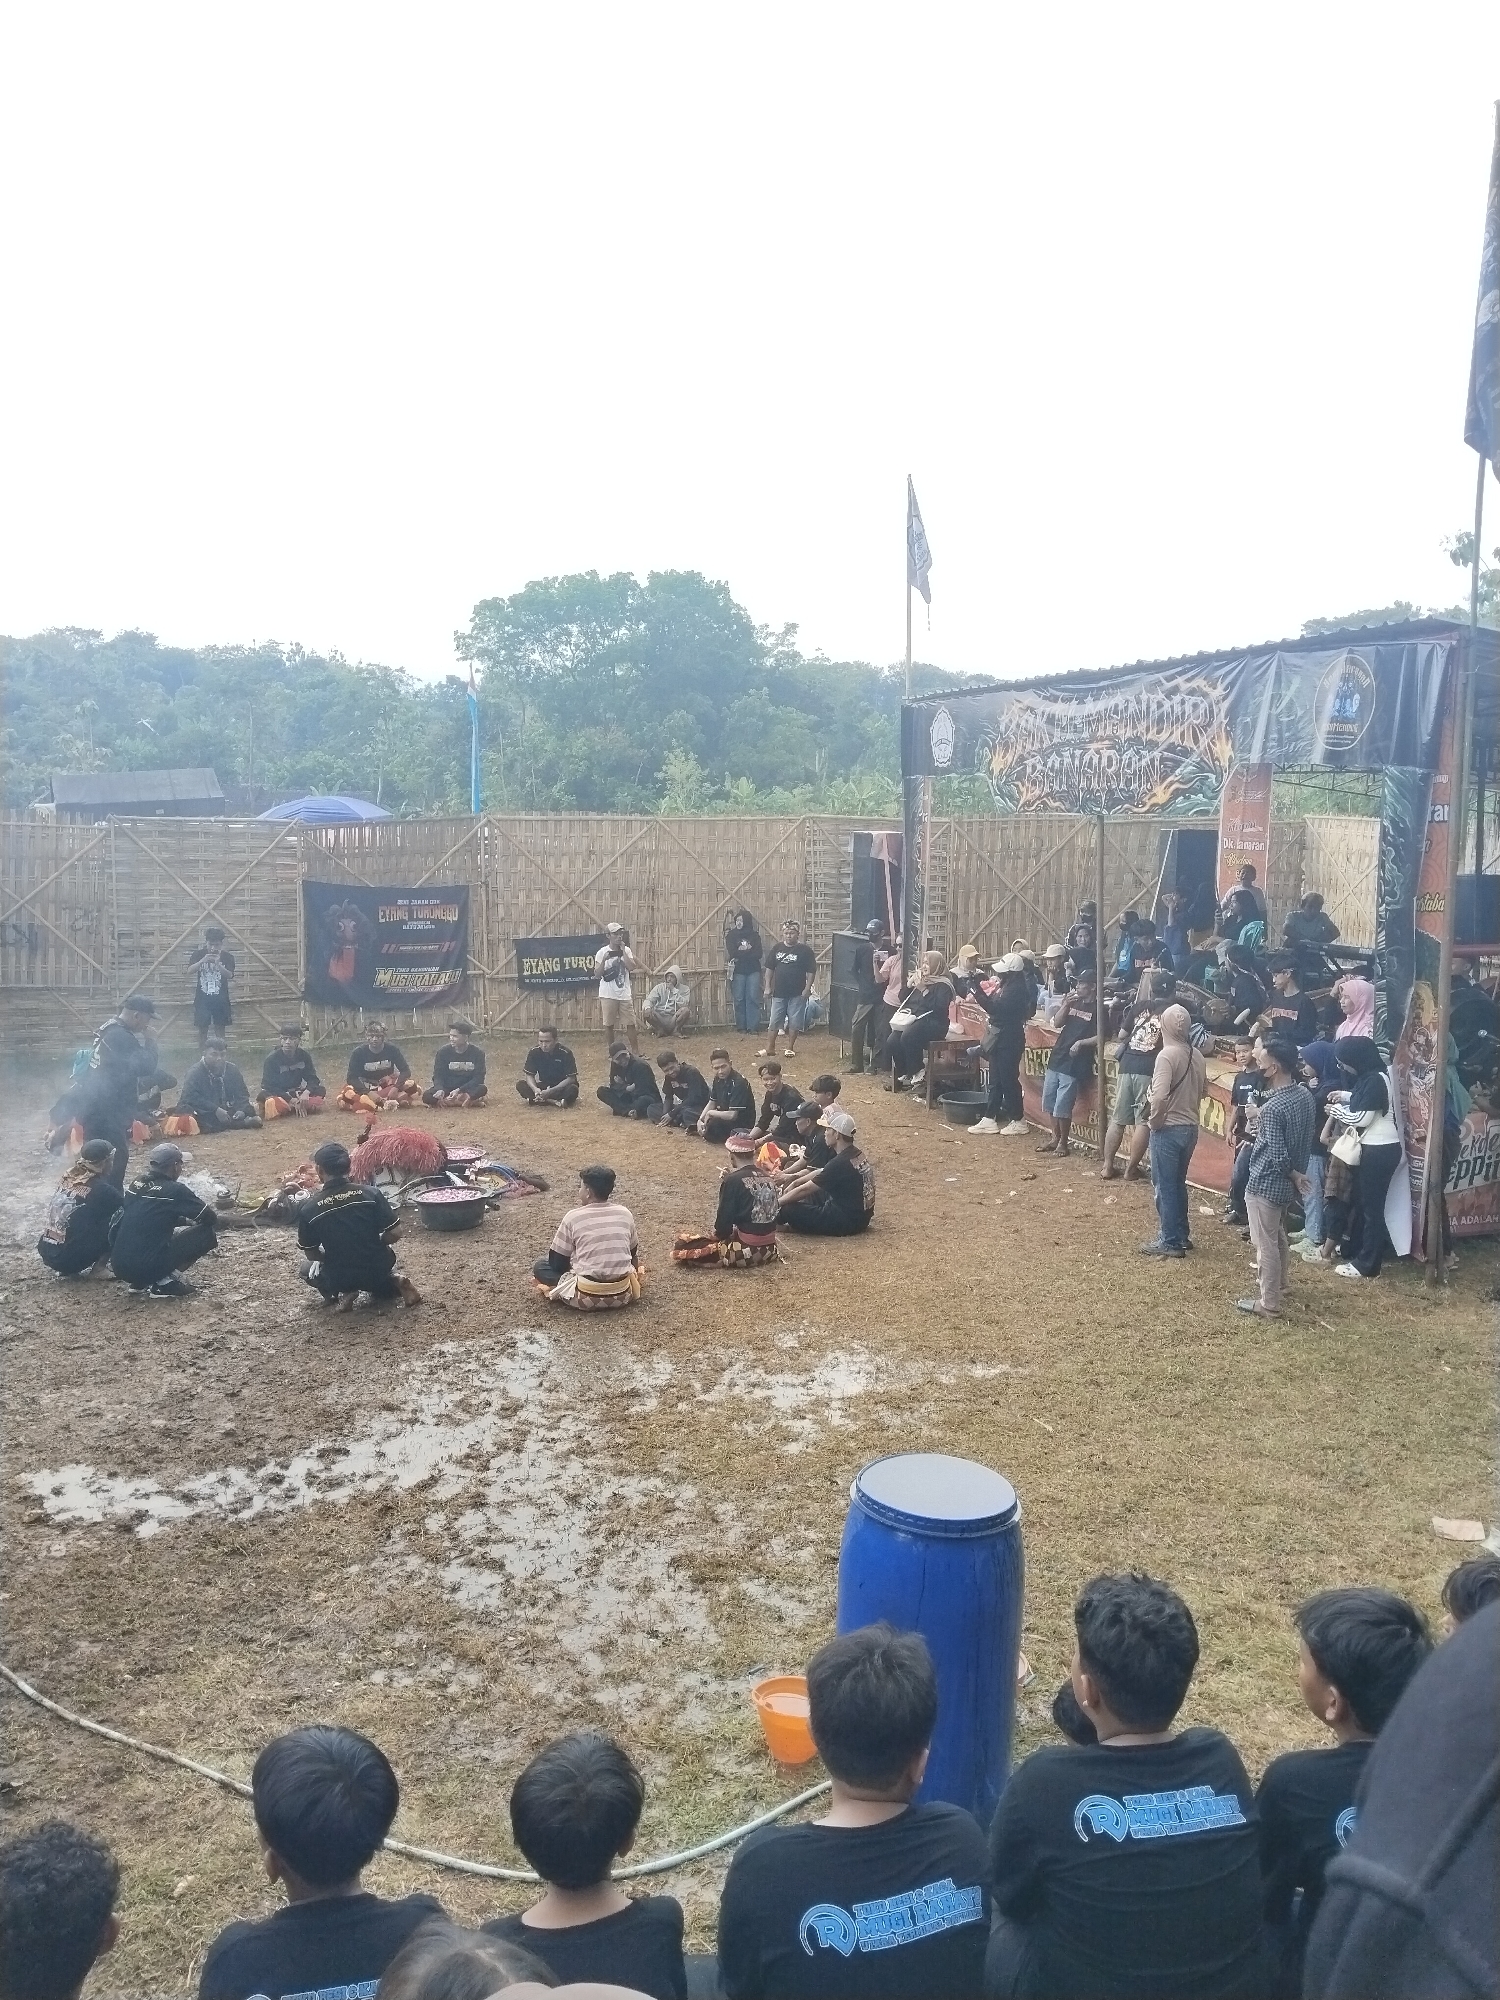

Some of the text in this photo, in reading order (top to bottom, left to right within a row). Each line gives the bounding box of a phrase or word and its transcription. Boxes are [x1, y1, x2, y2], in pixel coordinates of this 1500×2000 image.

[1023, 747, 1163, 800] BANARAN
[378, 904, 459, 923] EYANG TURONGGO
[521, 955, 595, 976] EYANG TURO
[1126, 1806, 1179, 1827] MUGI
[855, 1907, 914, 1939] MUGI
